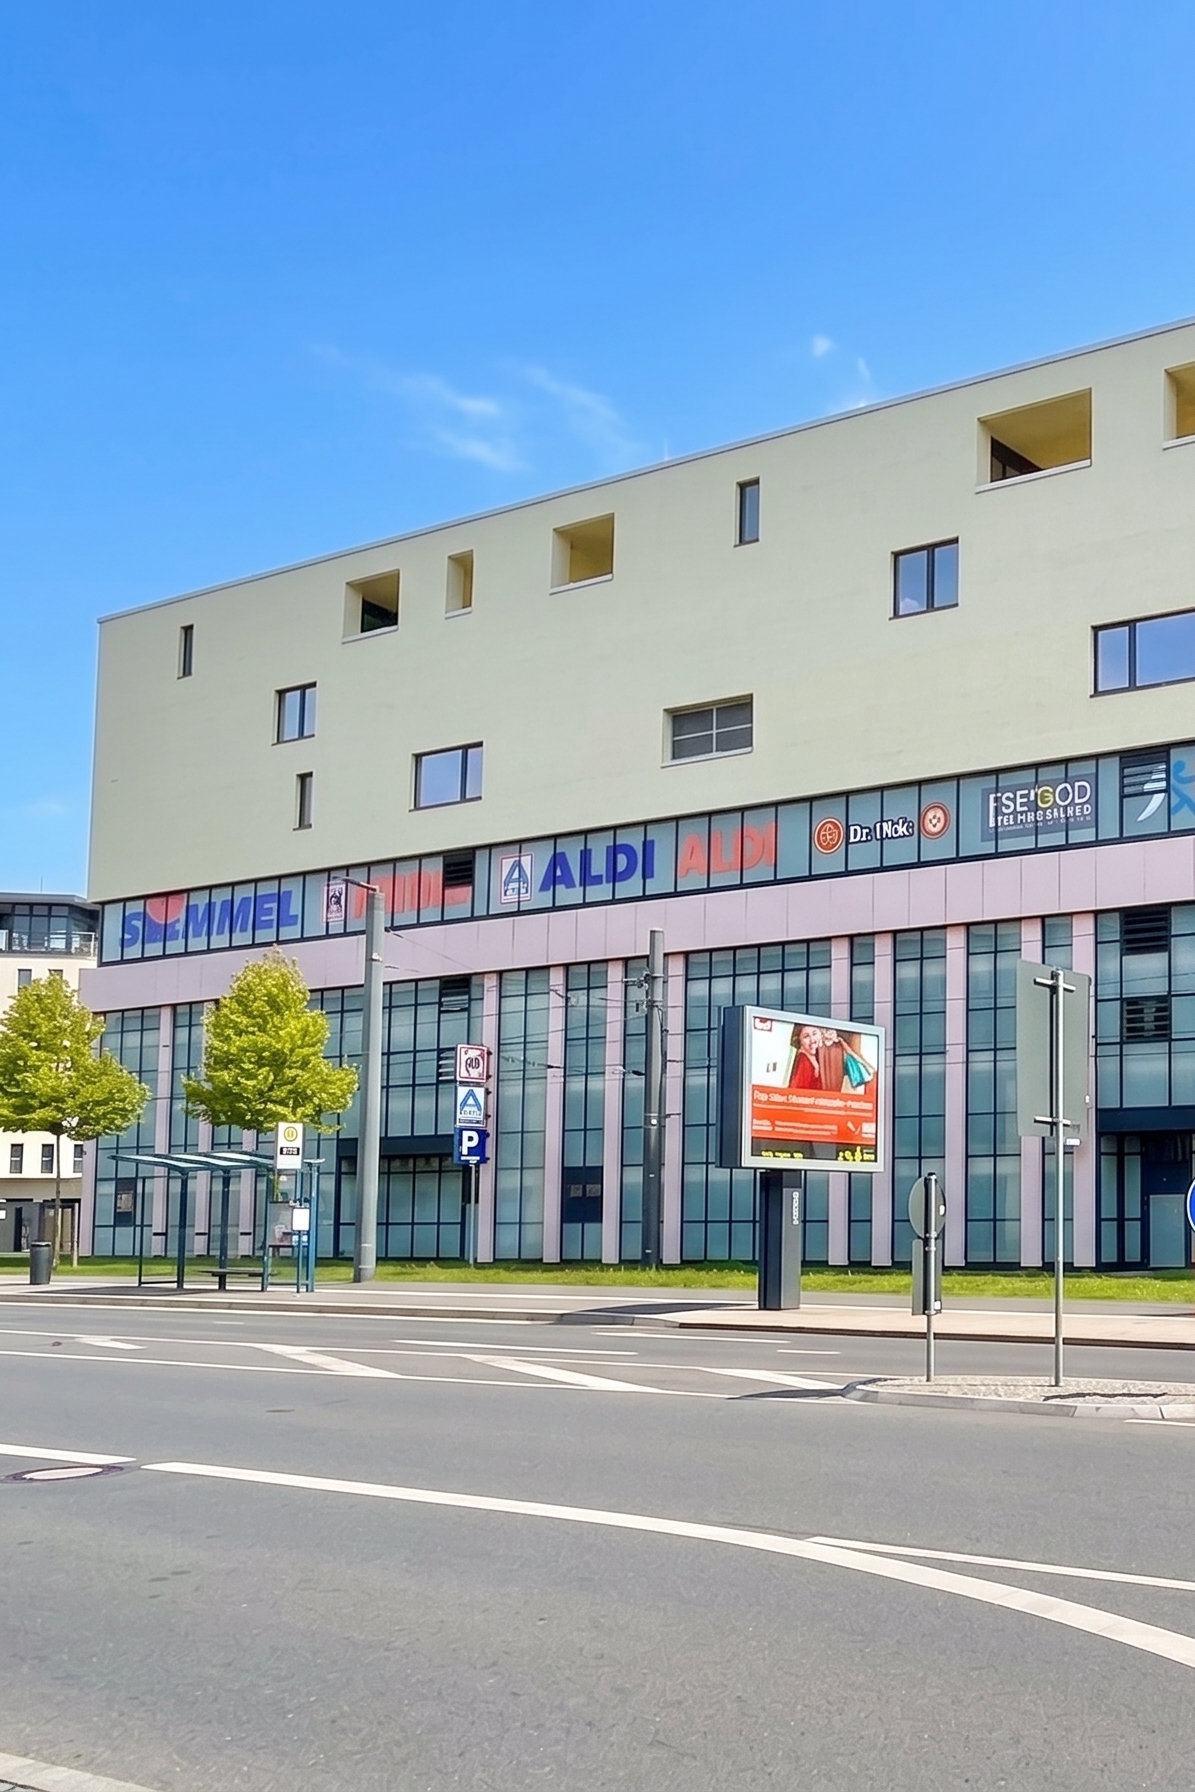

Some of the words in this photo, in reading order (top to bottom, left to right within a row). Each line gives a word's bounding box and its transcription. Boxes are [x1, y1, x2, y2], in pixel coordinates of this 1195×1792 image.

[678, 821, 778, 878] ALDI
[849, 825, 872, 843] Dr.
[538, 839, 655, 893] ALDI
[461, 1129, 480, 1156] P
